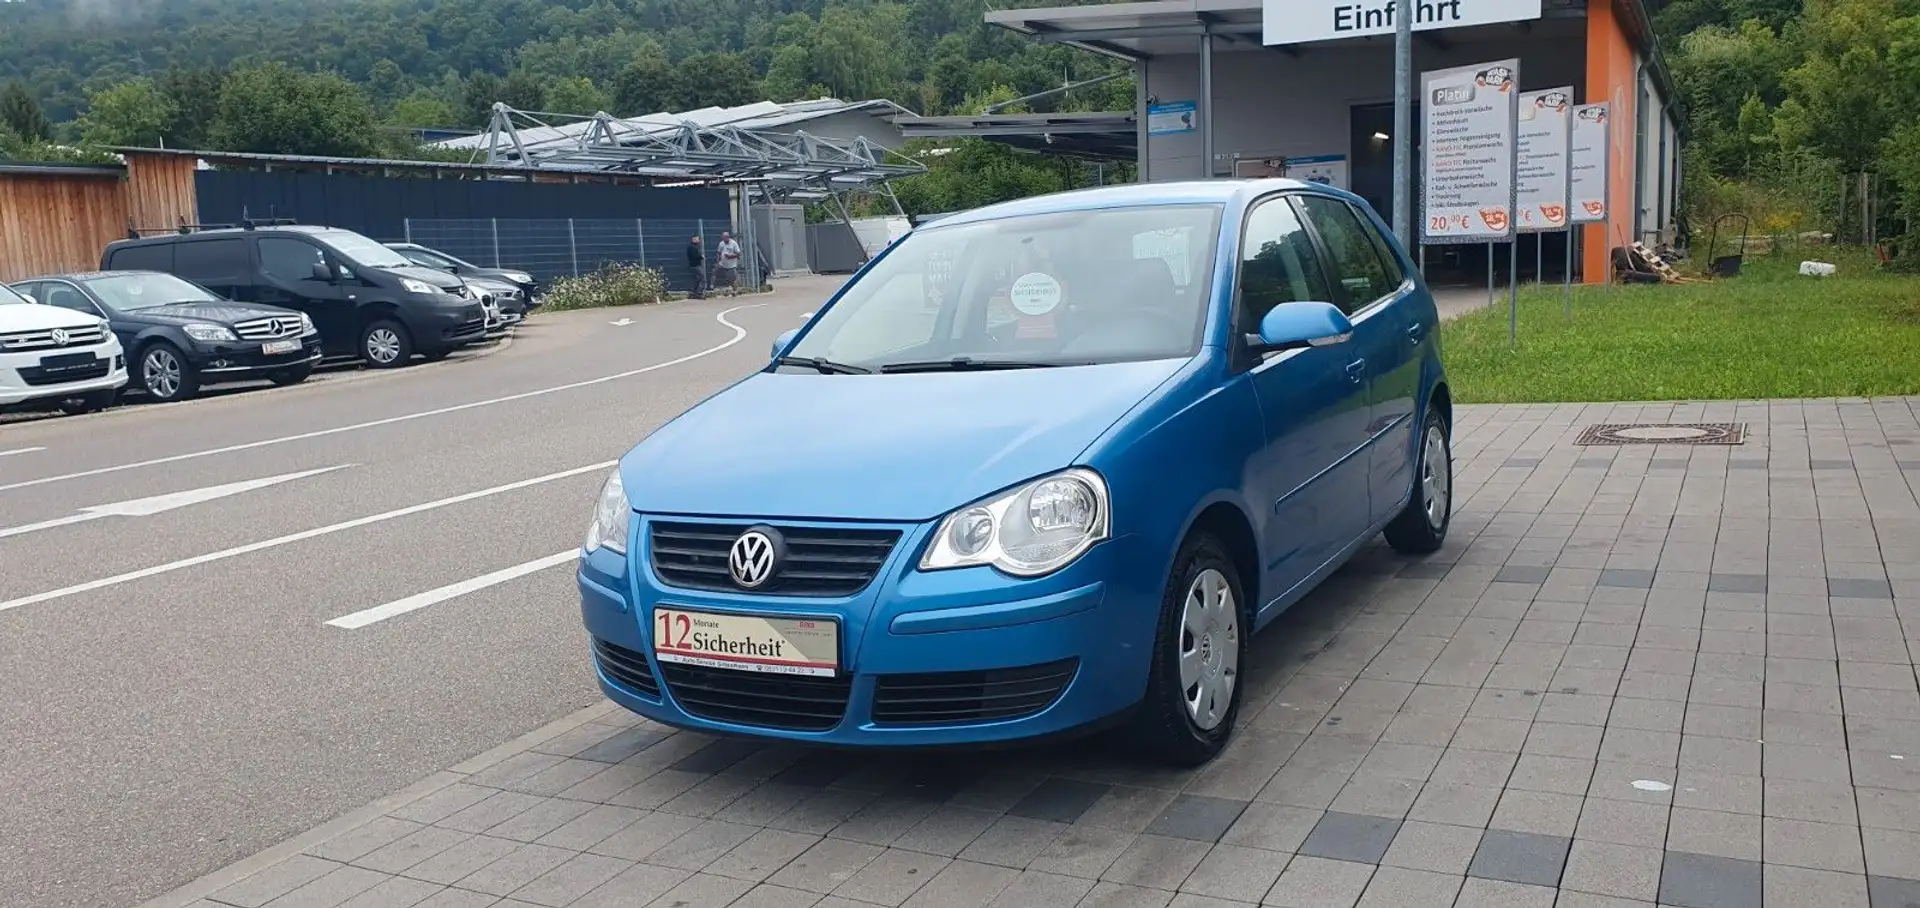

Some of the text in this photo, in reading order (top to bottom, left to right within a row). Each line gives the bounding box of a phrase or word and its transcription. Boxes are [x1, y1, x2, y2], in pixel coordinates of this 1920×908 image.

[1334, 0, 1461, 32] Einfhrt
[1437, 88, 1469, 103] Platin
[658, 612, 693, 650] 12
[693, 618, 720, 629] Monate
